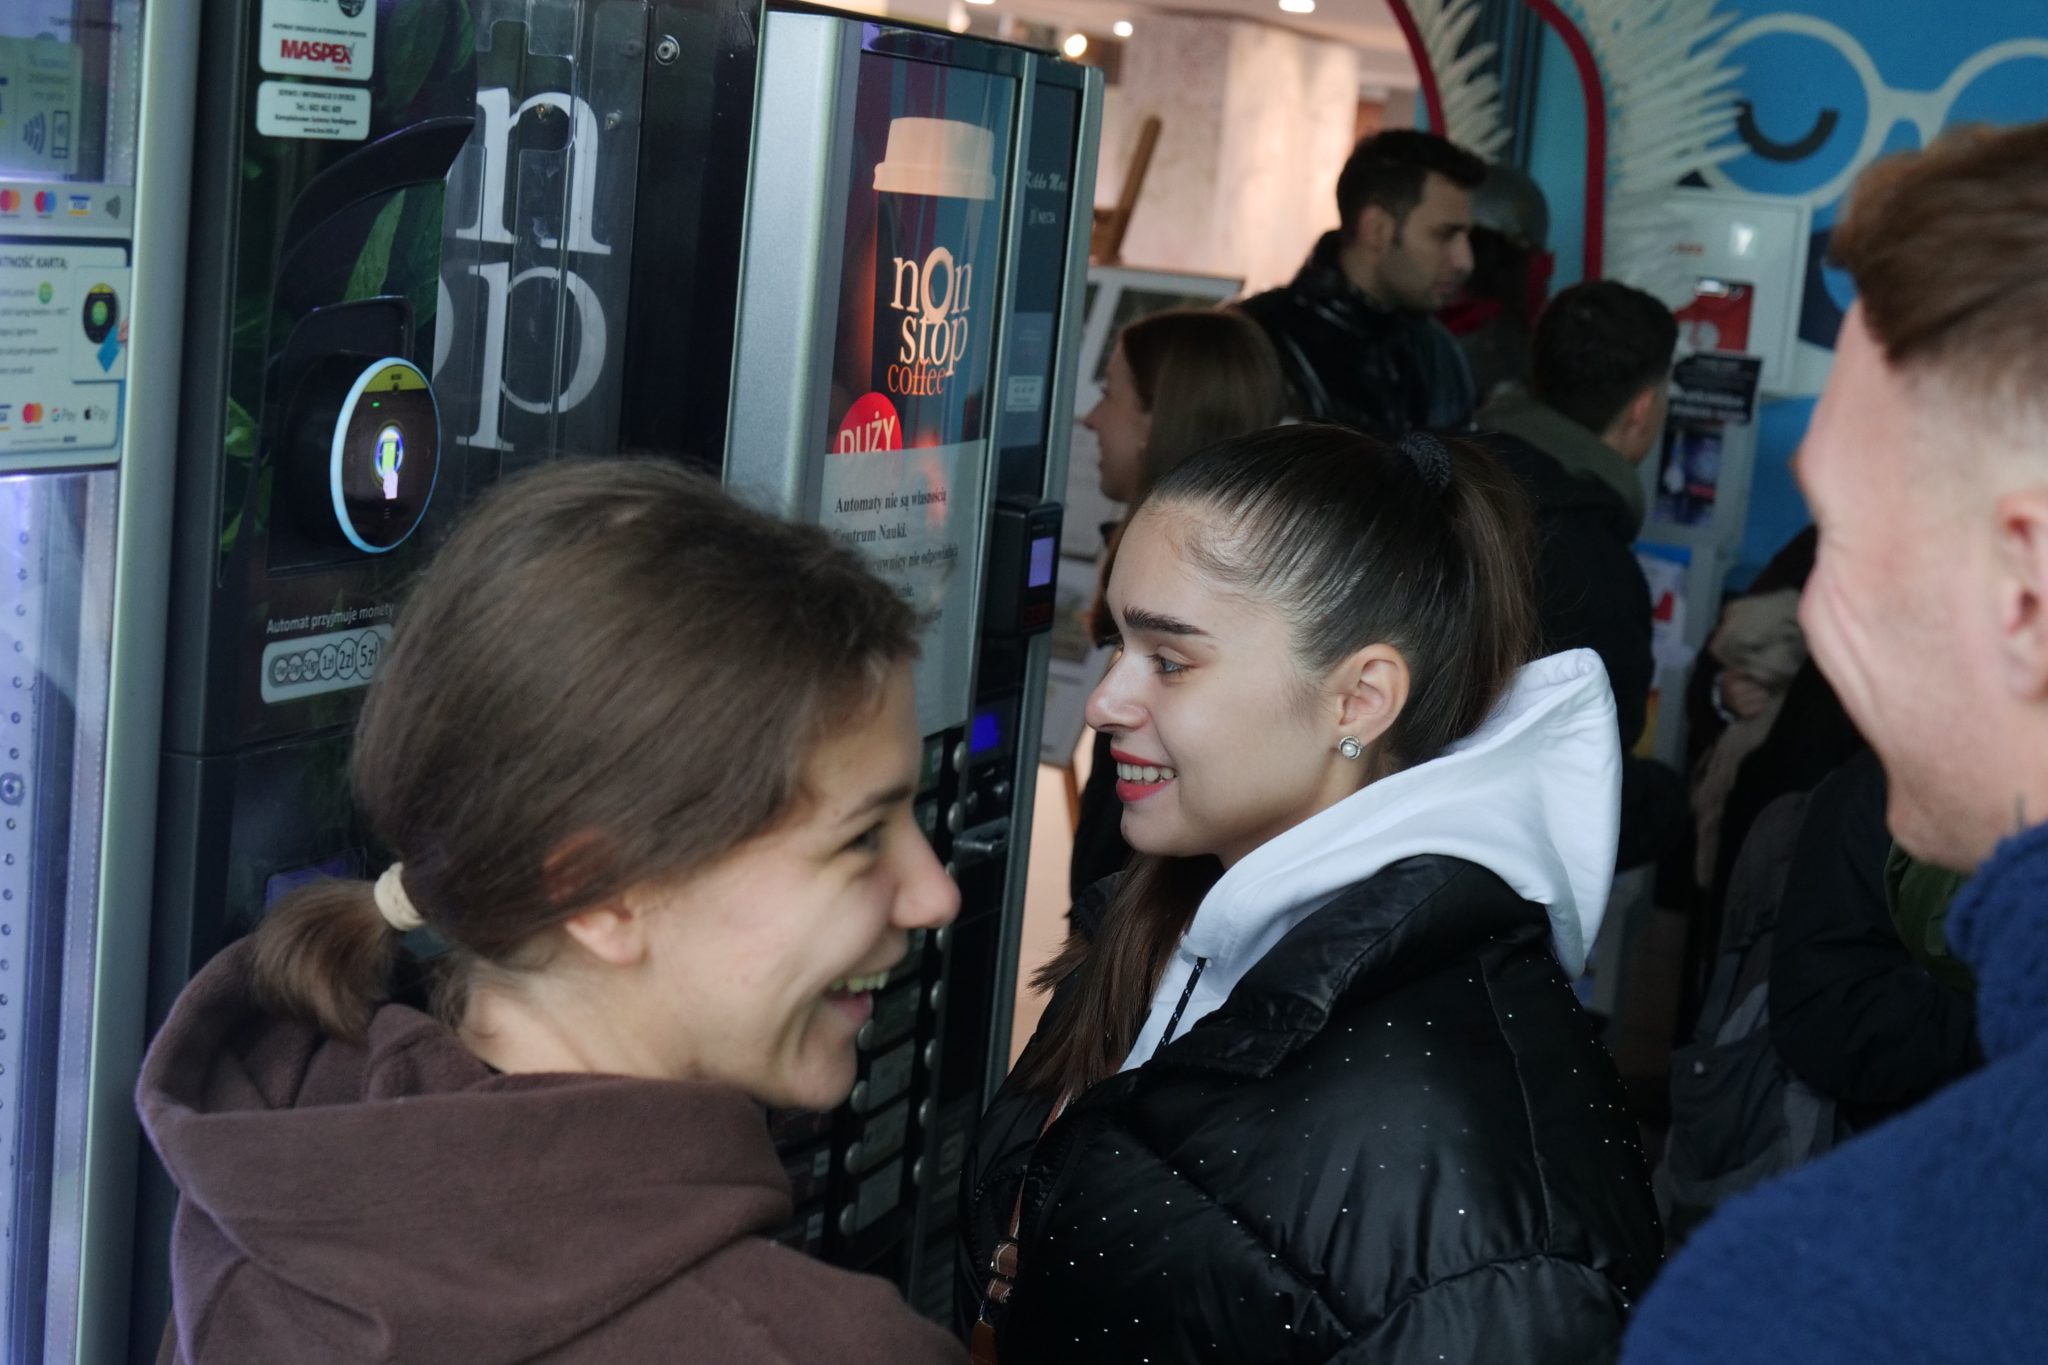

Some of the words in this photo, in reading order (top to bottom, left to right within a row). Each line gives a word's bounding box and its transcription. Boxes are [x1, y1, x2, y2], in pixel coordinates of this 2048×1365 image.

[280, 39, 356, 65] MASPEX
[899, 312, 969, 377] stop
[887, 360, 947, 397] coffee
[834, 494, 882, 514] Automaty
[884, 492, 899, 510] nie
[900, 493, 910, 512] są
[266, 616, 310, 634] Automat
[311, 606, 357, 631] przyjmuje
